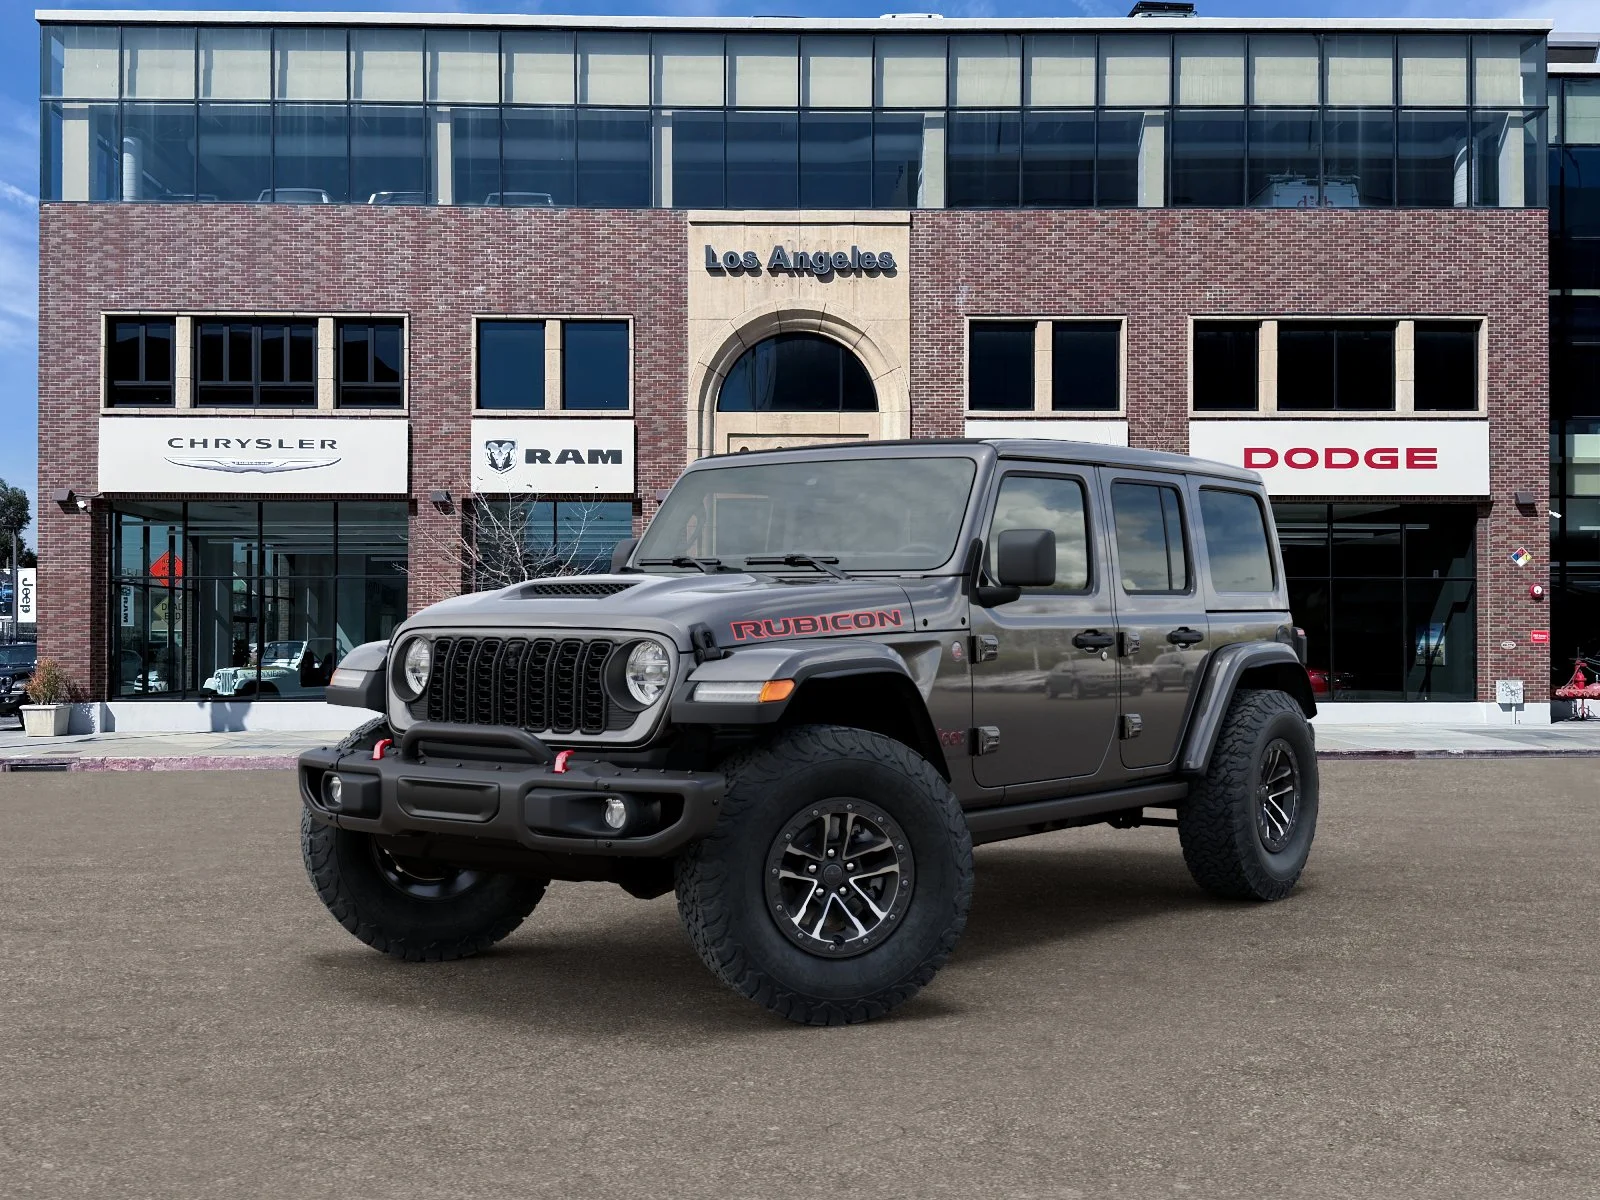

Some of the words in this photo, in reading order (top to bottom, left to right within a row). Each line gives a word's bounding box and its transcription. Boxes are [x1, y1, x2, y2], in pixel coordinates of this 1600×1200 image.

[704, 244, 760, 270] Los
[767, 244, 896, 275] Angeles
[167, 437, 338, 450] CHRYSLER
[524, 448, 623, 465] RAM
[1243, 447, 1438, 470] DODGE
[20, 577, 33, 614] Jeep
[164, 612, 181, 620] ED
[730, 609, 903, 641] RUBICON
